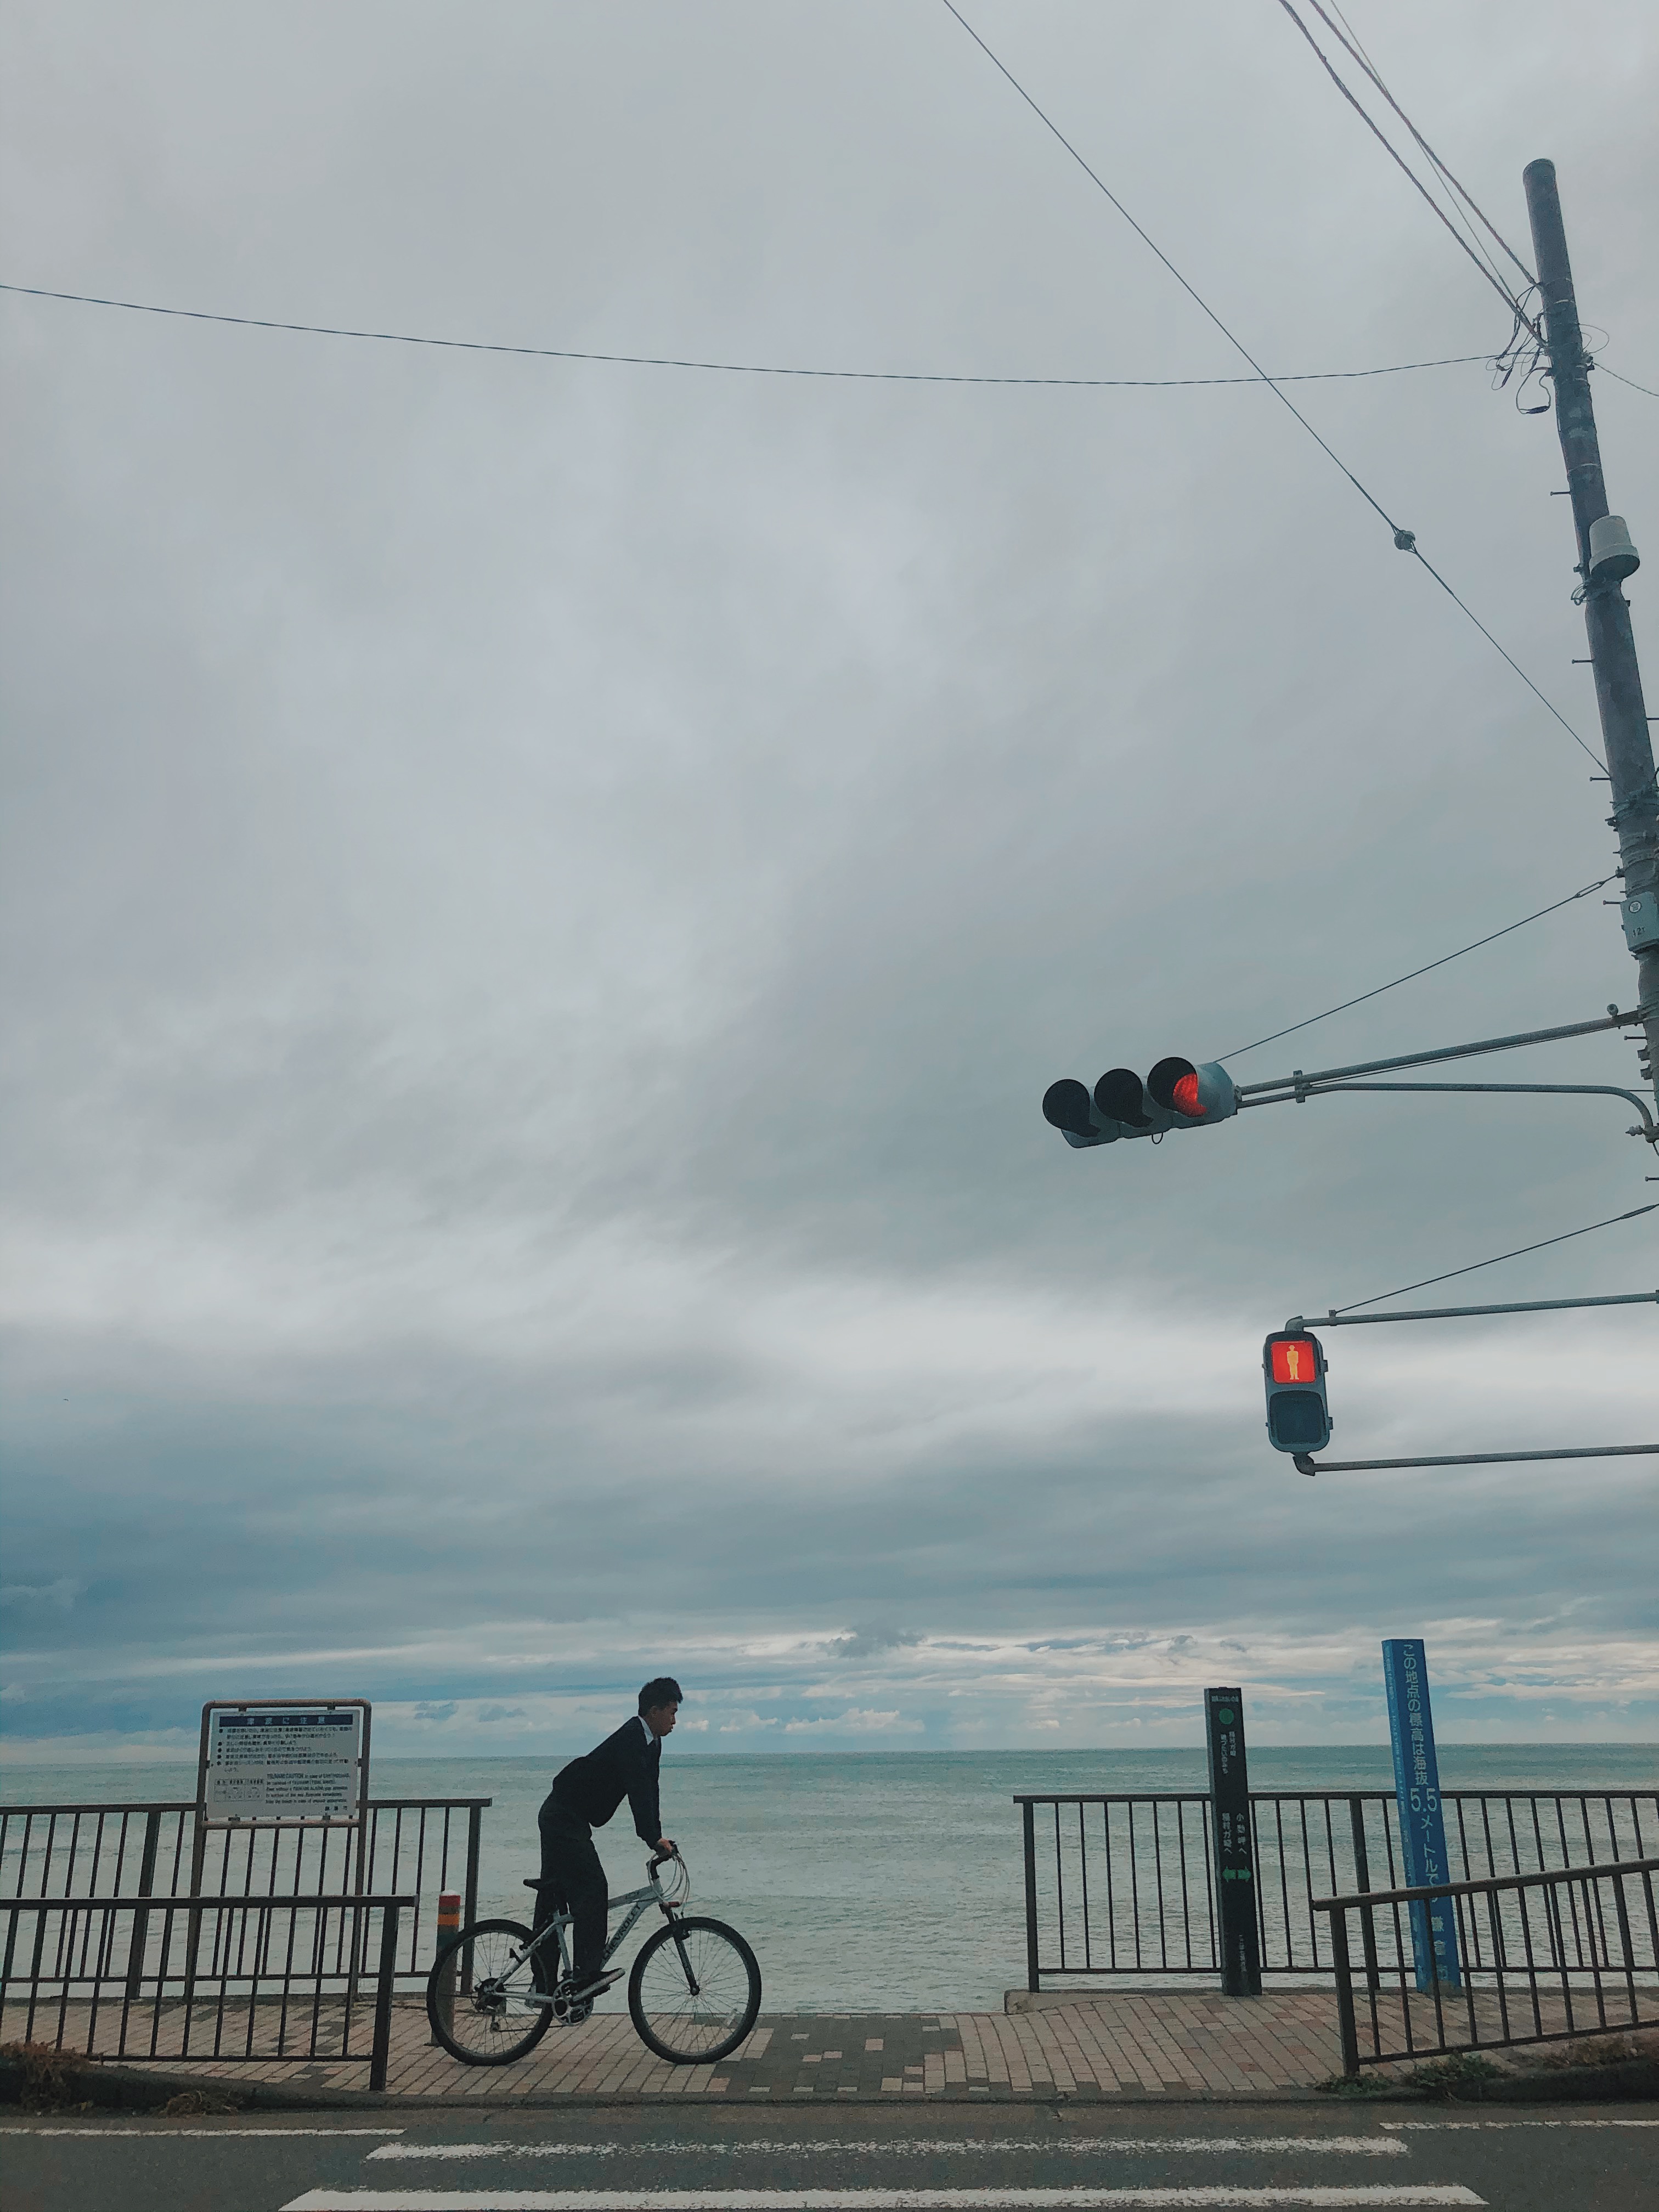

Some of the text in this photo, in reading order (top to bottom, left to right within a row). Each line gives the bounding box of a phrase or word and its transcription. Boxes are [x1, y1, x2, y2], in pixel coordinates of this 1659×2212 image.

[247, 1716, 325, 1725] 津波に注意
[1403, 1644, 1429, 1786] この地点の標高は海抜
[1410, 1787, 1437, 1812] 5.5
[603, 1903, 641, 1960] CHEVROLET
